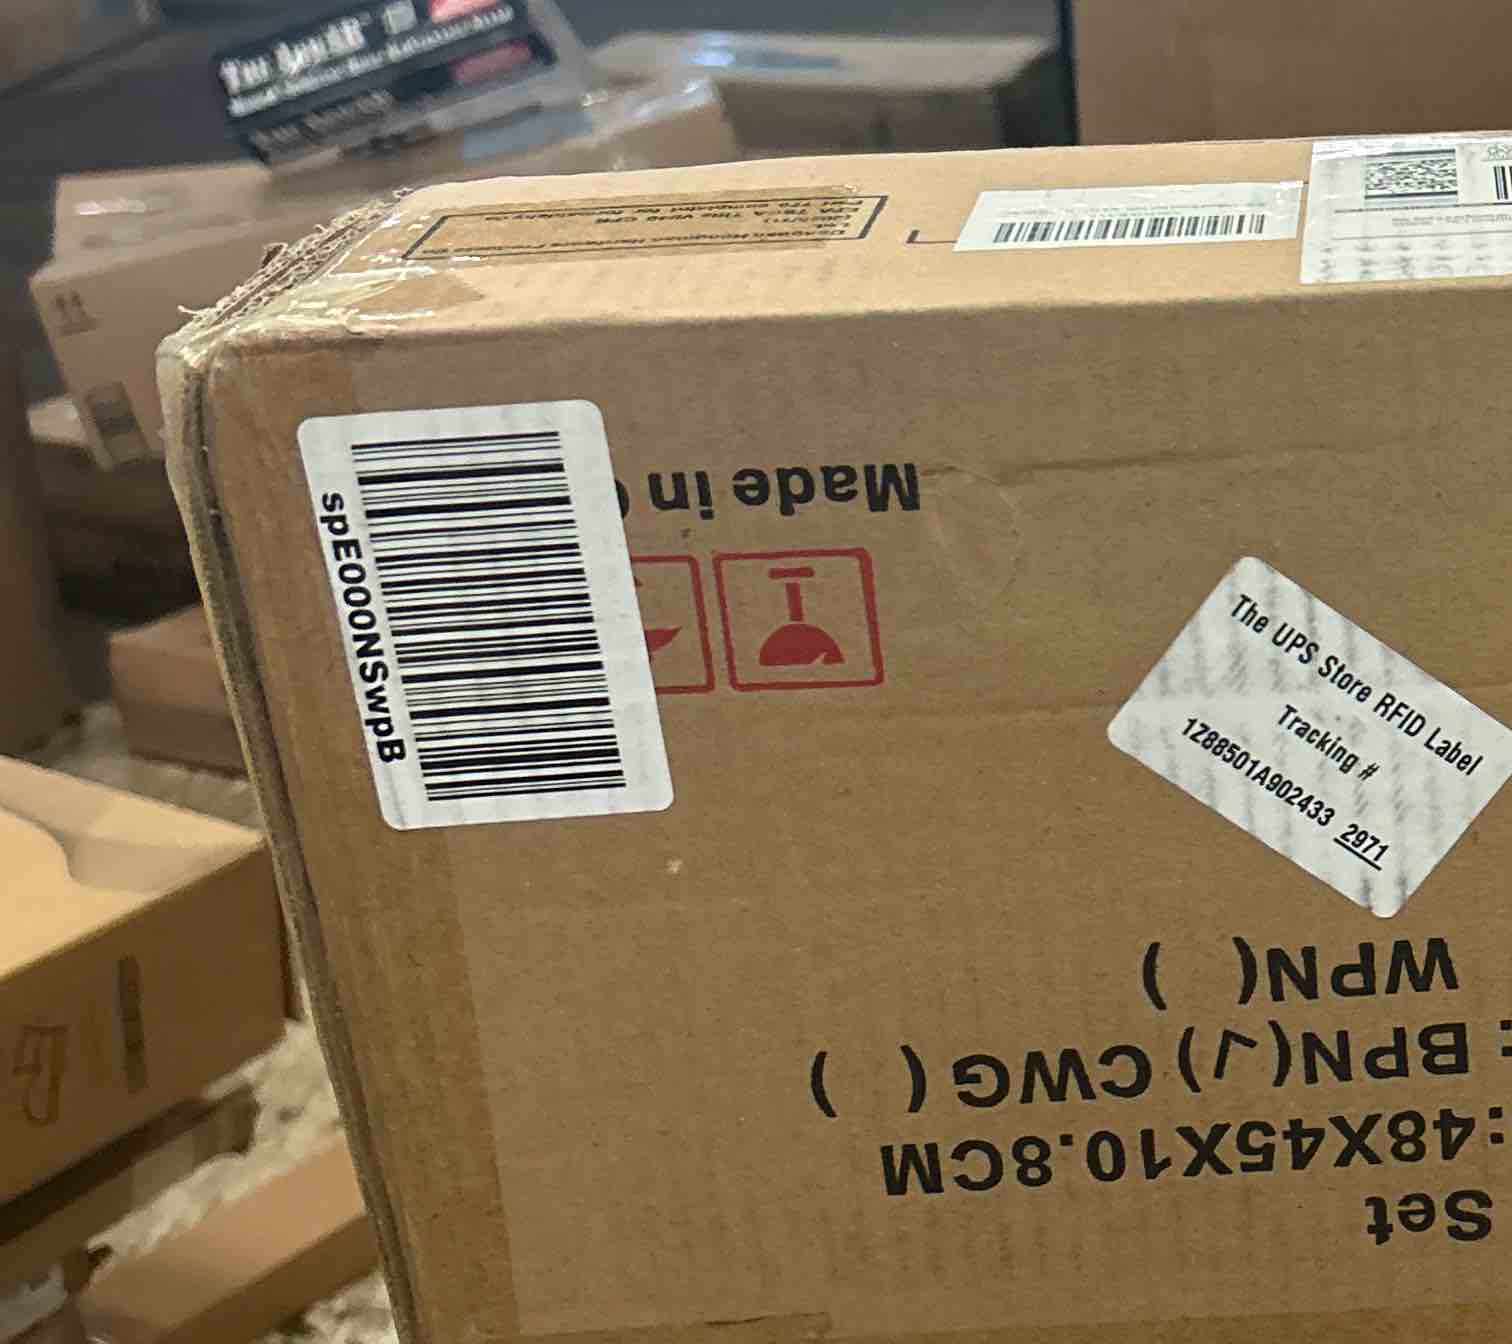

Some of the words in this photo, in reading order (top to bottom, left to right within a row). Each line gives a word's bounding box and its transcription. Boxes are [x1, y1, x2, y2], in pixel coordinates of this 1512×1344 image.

[648, 469, 714, 521] in
[731, 463, 921, 519] Made
[321, 491, 406, 765] spE000NSwpB
[1230, 594, 1269, 633] The
[1271, 622, 1320, 665] UPS
[1317, 655, 1372, 703] Store
[1372, 692, 1426, 738] RFID
[1424, 727, 1484, 777] Label
[1276, 704, 1360, 775] Tracking
[1358, 761, 1379, 782] #
[1181, 717, 1336, 828] 1Z88501A902433
[1339, 822, 1390, 864] 2971
[1366, 1187, 1493, 1245] Set
